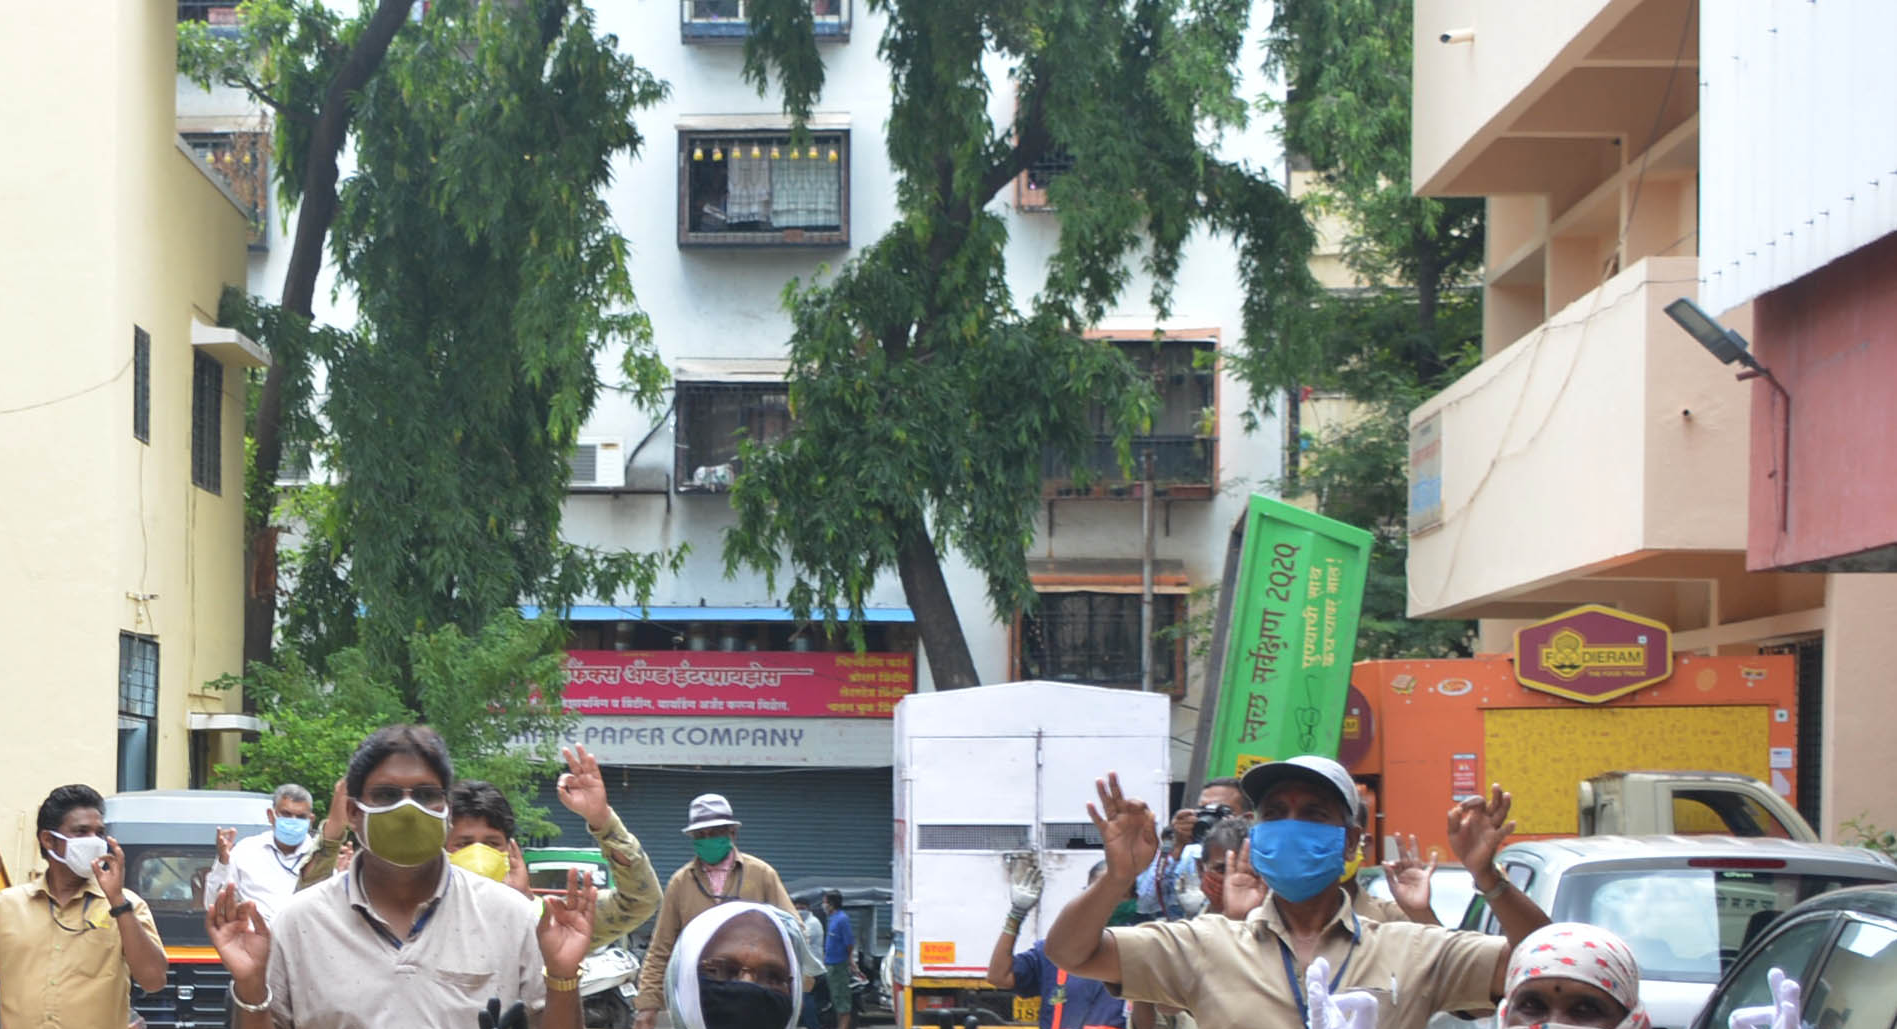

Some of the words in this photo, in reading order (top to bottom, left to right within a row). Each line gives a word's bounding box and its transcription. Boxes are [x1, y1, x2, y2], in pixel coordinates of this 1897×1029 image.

[584, 726, 664, 746] PAPER
[672, 726, 804, 746] COMPANY
[1238, 692, 1269, 744] स्वच्छ
